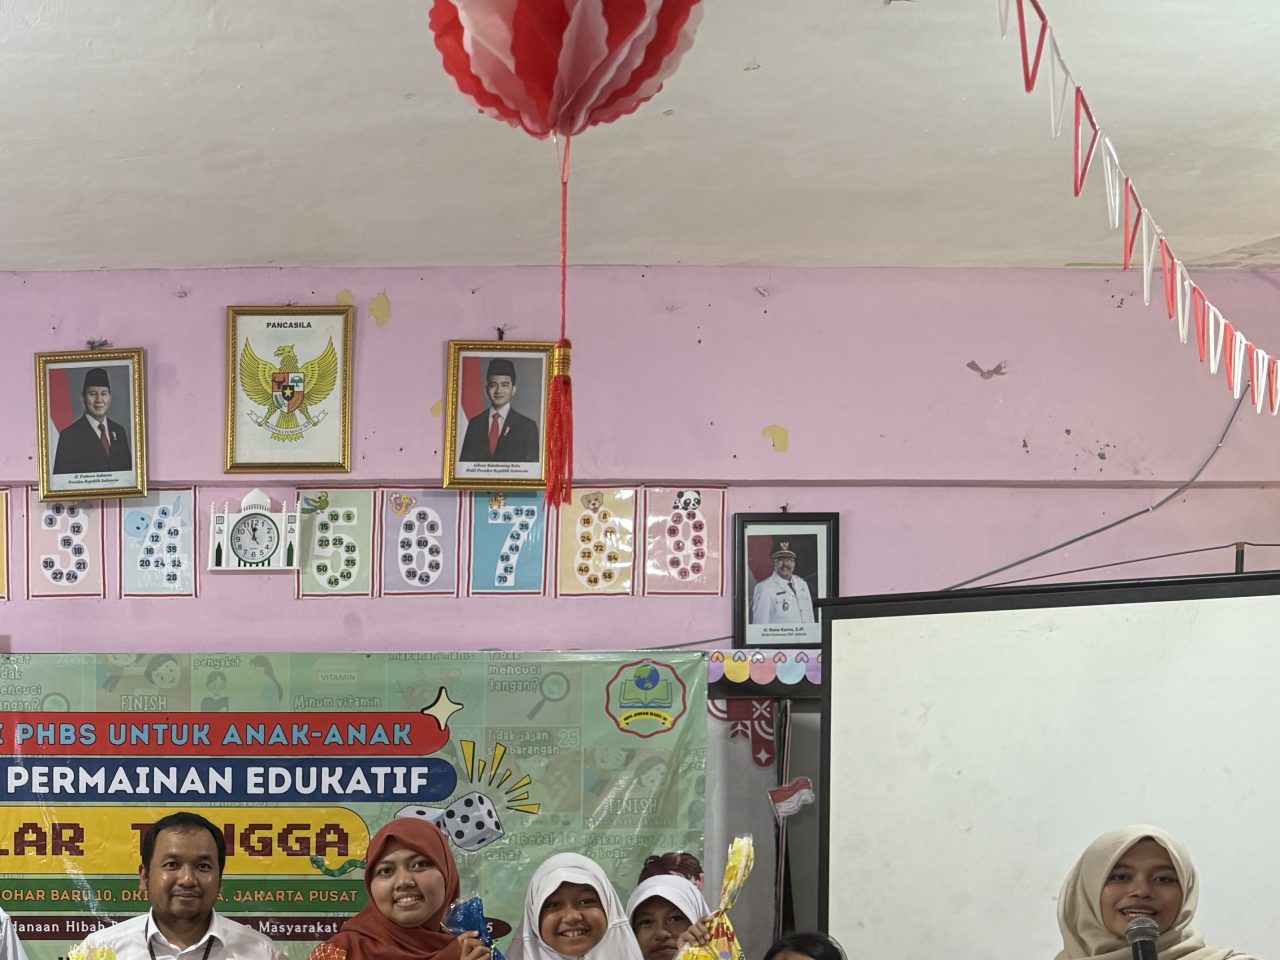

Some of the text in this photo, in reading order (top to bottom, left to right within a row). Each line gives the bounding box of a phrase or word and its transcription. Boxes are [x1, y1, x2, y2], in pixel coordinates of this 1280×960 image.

[194, 656, 240, 670] penyakit
[489, 665, 542, 674] mencuci
[320, 673, 356, 682] VITAMIN
[489, 678, 539, 692] tangan?
[120, 696, 168, 712] FINISH
[294, 695, 381, 709] Minum vitamin
[16, 722, 96, 745] PHBS
[108, 723, 210, 745] UNTUK
[222, 722, 412, 745] ANAK-ANAK
[7, 766, 233, 794] PERMAINAN
[246, 766, 429, 794] EDUKATIF
[131, 823, 348, 856] TGGA
[51, 890, 90, 900] BARU
[96, 890, 116, 902] 10,
[122, 890, 148, 901] DKI
[234, 891, 304, 901] JAKARTA
[309, 891, 358, 901] PUSAT
[12, 920, 59, 932] danaan
[66, 920, 105, 932] Hibah
[260, 922, 338, 934] Masyarakat
